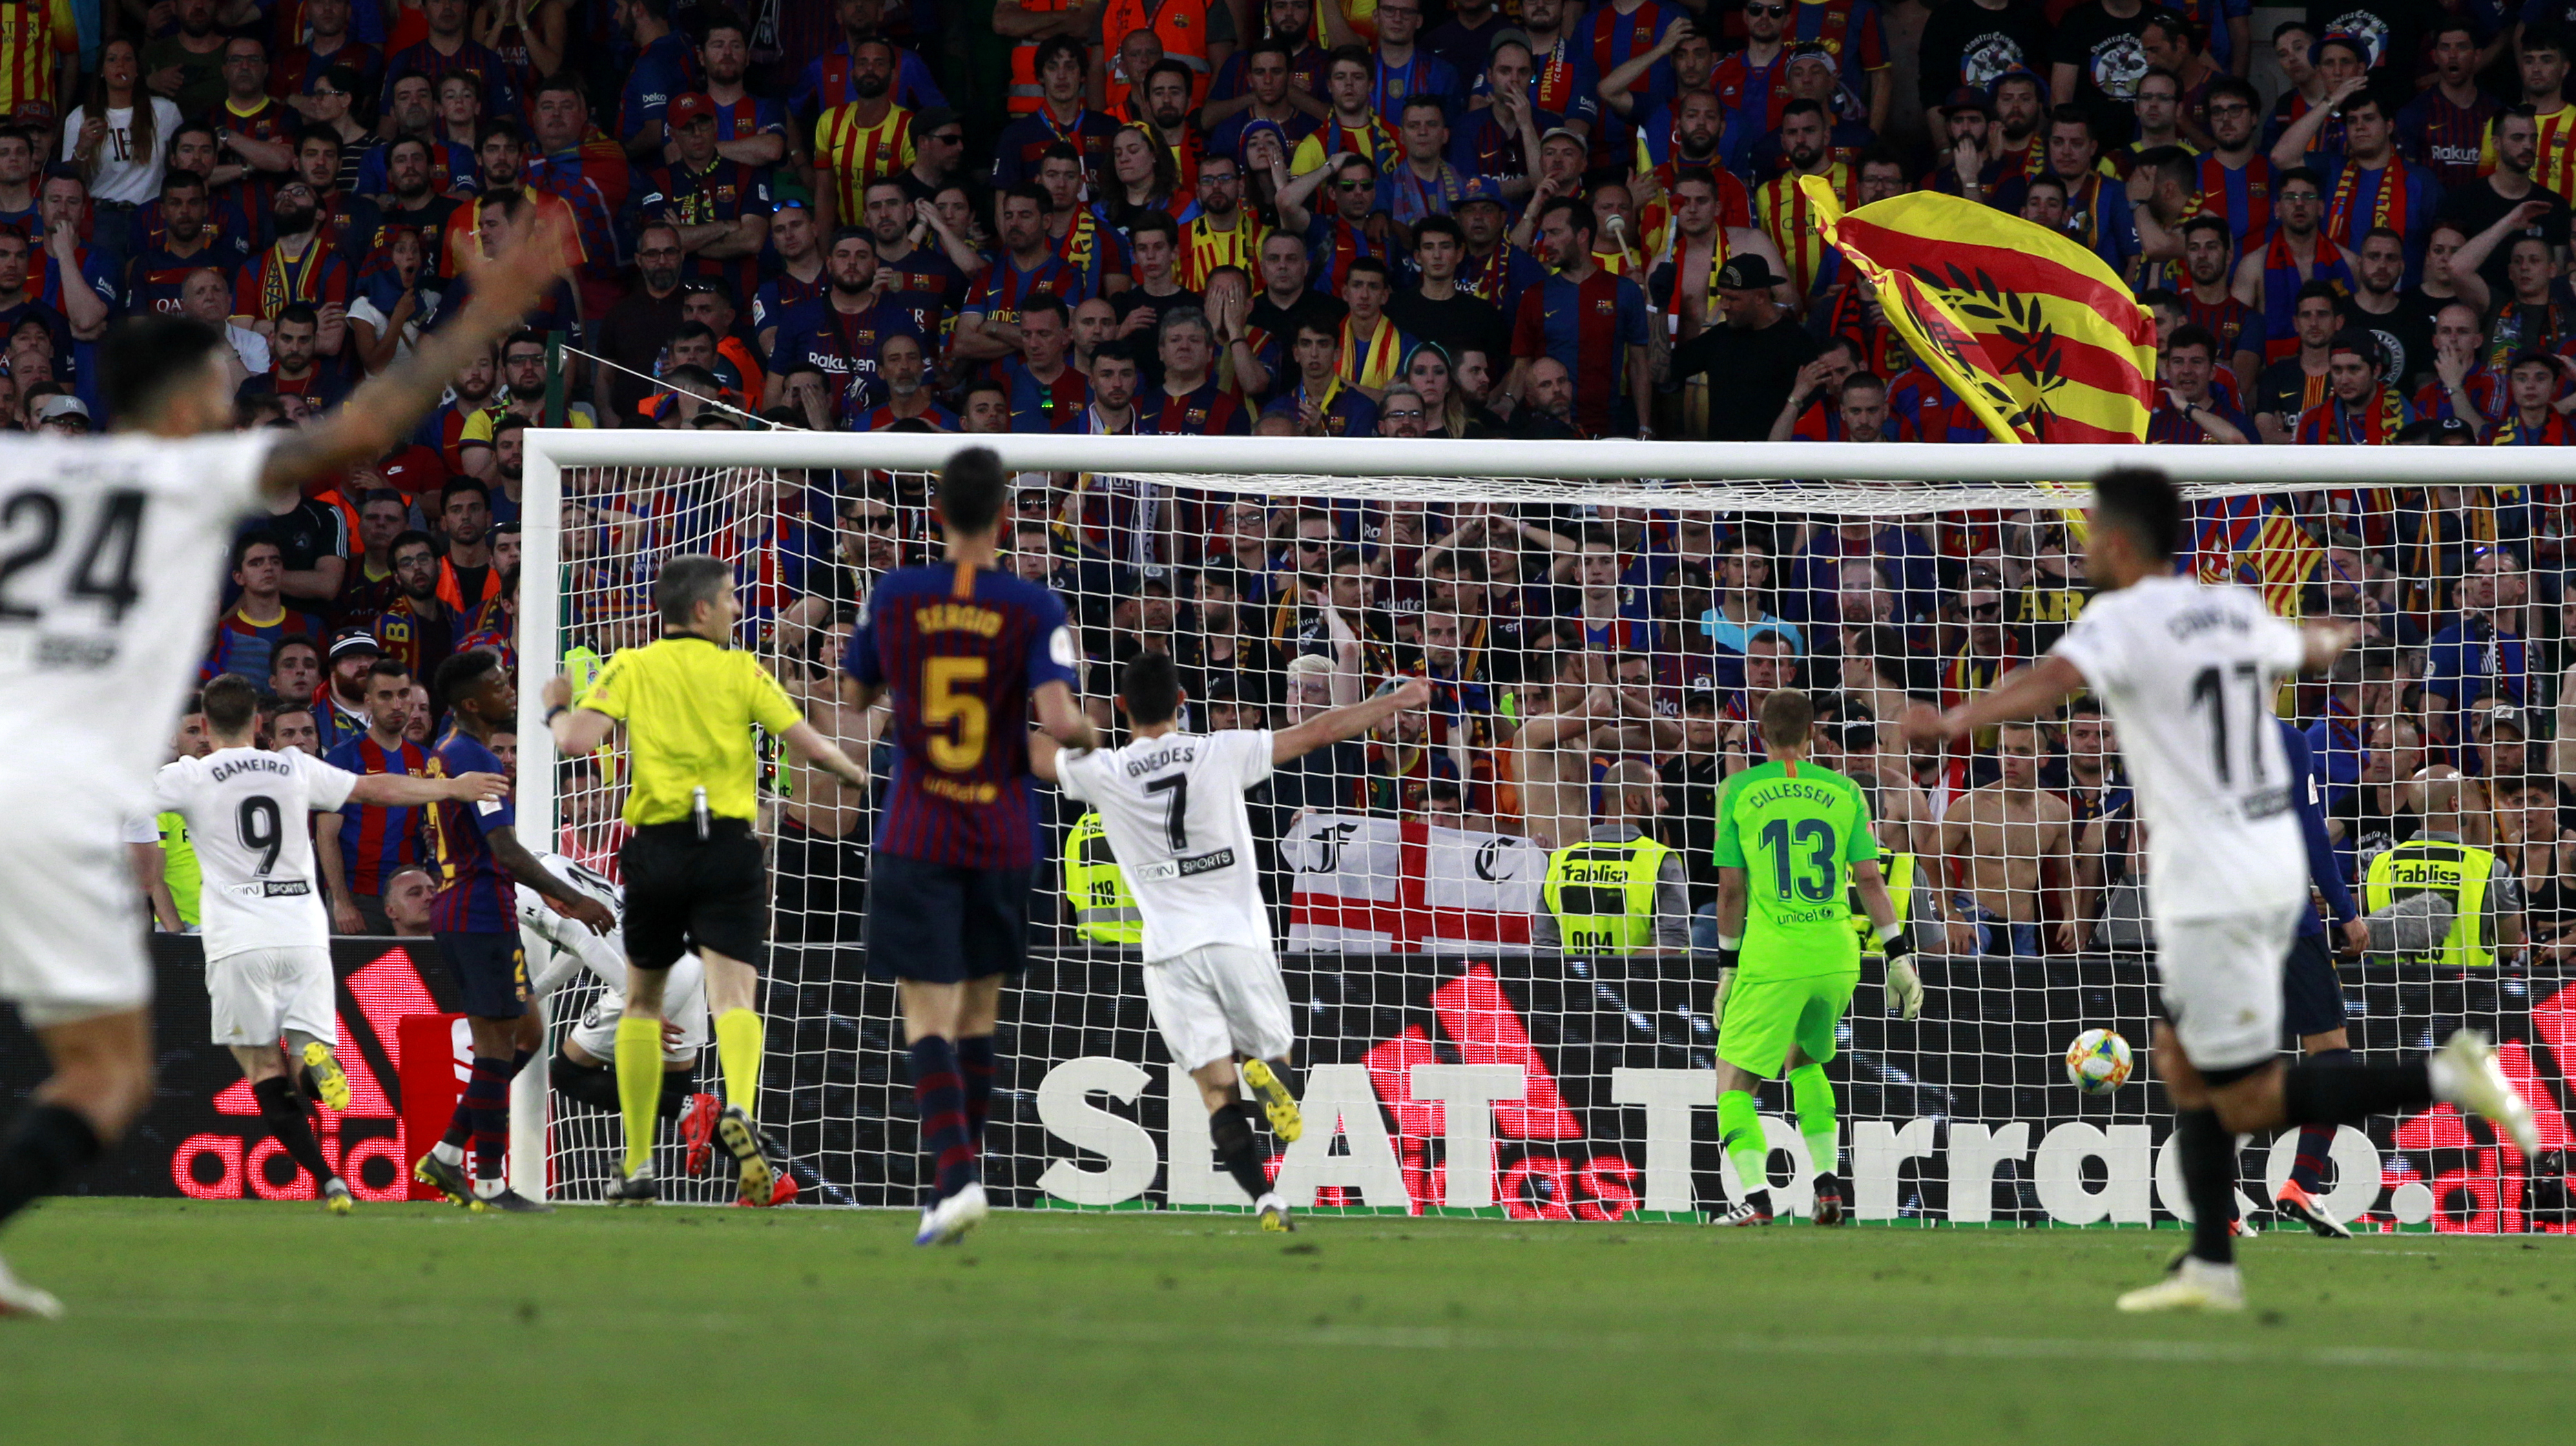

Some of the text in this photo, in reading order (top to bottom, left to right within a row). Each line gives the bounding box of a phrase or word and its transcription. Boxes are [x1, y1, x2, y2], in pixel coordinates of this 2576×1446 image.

[643, 92, 667, 103] beko
[2431, 145, 2480, 162] Rakut
[987, 307, 1021, 324] unic
[0, 490, 149, 623] 24
[916, 603, 1004, 638] SERGIO
[924, 656, 988, 772] 5
[2191, 661, 2266, 787] 17
[212, 759, 291, 782] GAMEIRO
[1126, 747, 1195, 777] GUEDES
[1749, 783, 1836, 809] CILLESSEN
[1141, 772, 1187, 855] 7
[242, 794, 284, 878] 9
[1182, 852, 1232, 876] SPORTS
[1759, 818, 1836, 903] 13
[1561, 864, 1628, 885] Trablisa
[2389, 864, 2462, 886] Trablisa
[267, 882, 308, 896] SPORTS
[1777, 909, 1818, 925] unicef
[1572, 931, 1614, 956] 094
[1037, 1056, 1525, 1208] SEAT
